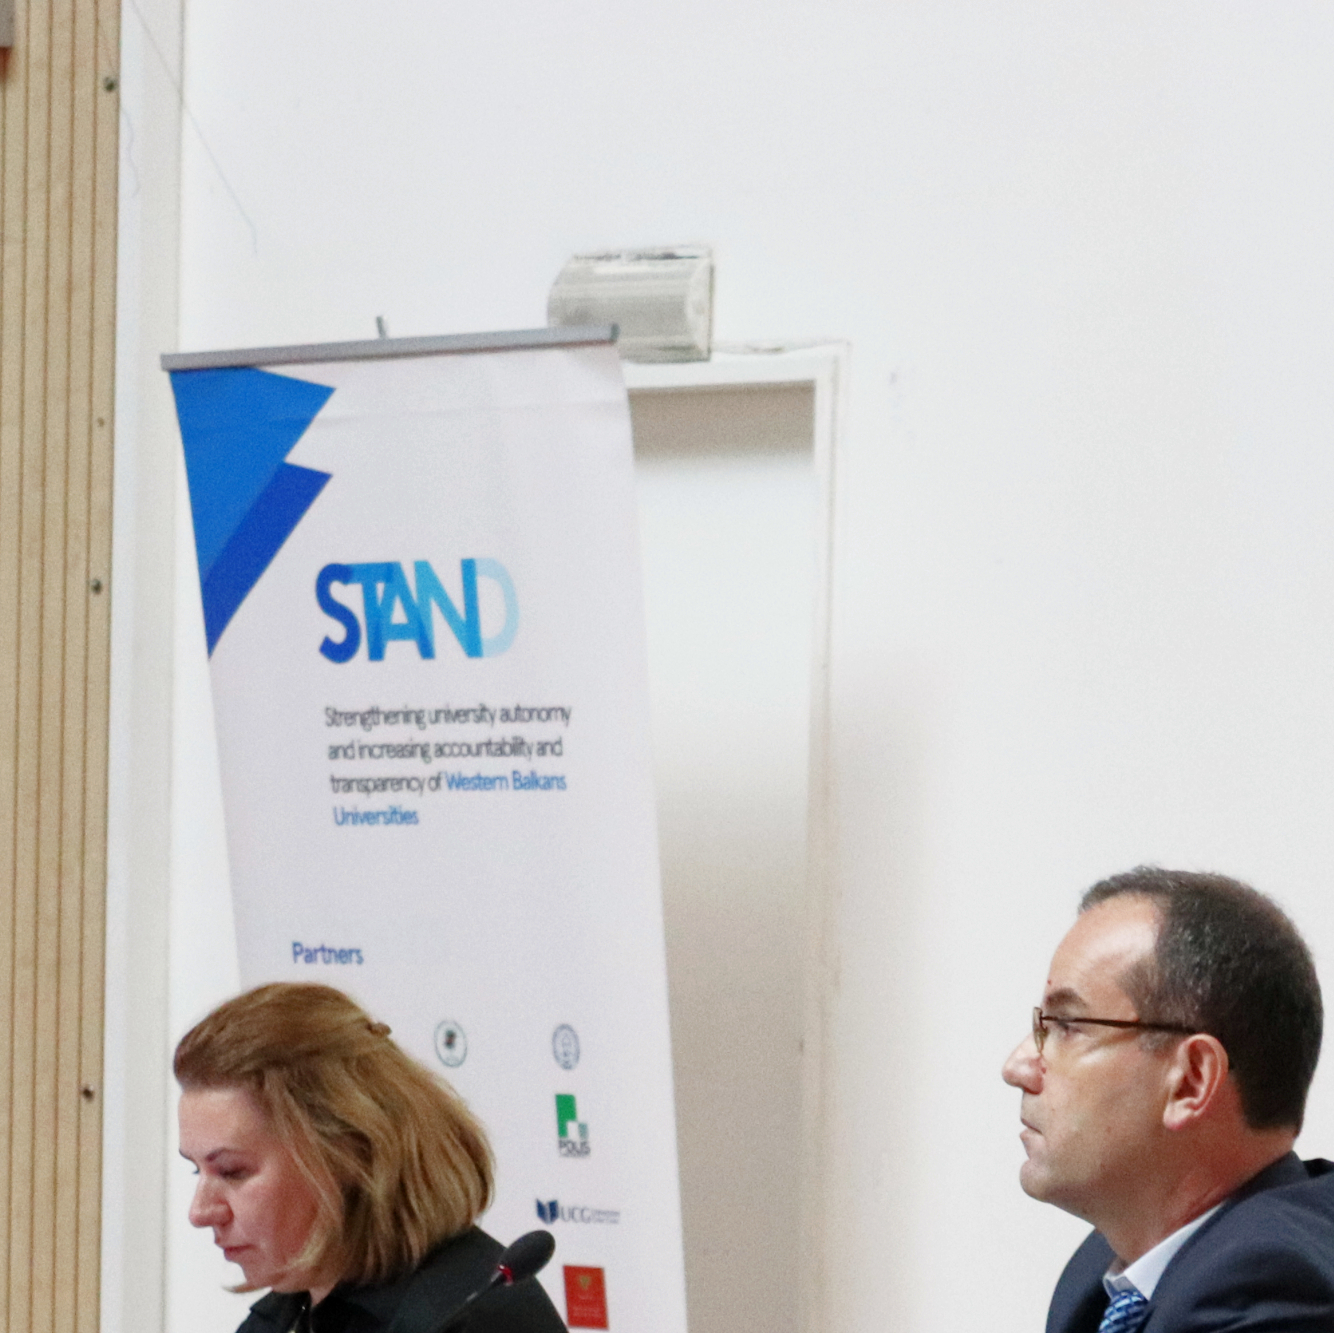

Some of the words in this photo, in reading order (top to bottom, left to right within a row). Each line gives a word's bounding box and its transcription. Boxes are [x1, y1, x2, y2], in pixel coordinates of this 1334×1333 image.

[315, 557, 520, 664] STAND
[325, 705, 427, 732] Strengthening
[429, 703, 497, 726] university
[499, 704, 572, 727] autonomy
[328, 741, 355, 760] and
[358, 739, 433, 764] increasing
[434, 736, 534, 759] accountability
[536, 736, 563, 757] and
[330, 775, 426, 798] transparency
[427, 772, 442, 793] of
[445, 772, 509, 791] Western
[512, 770, 567, 791] Balkans
[333, 806, 419, 826] Universities
[292, 942, 364, 965] Partners
